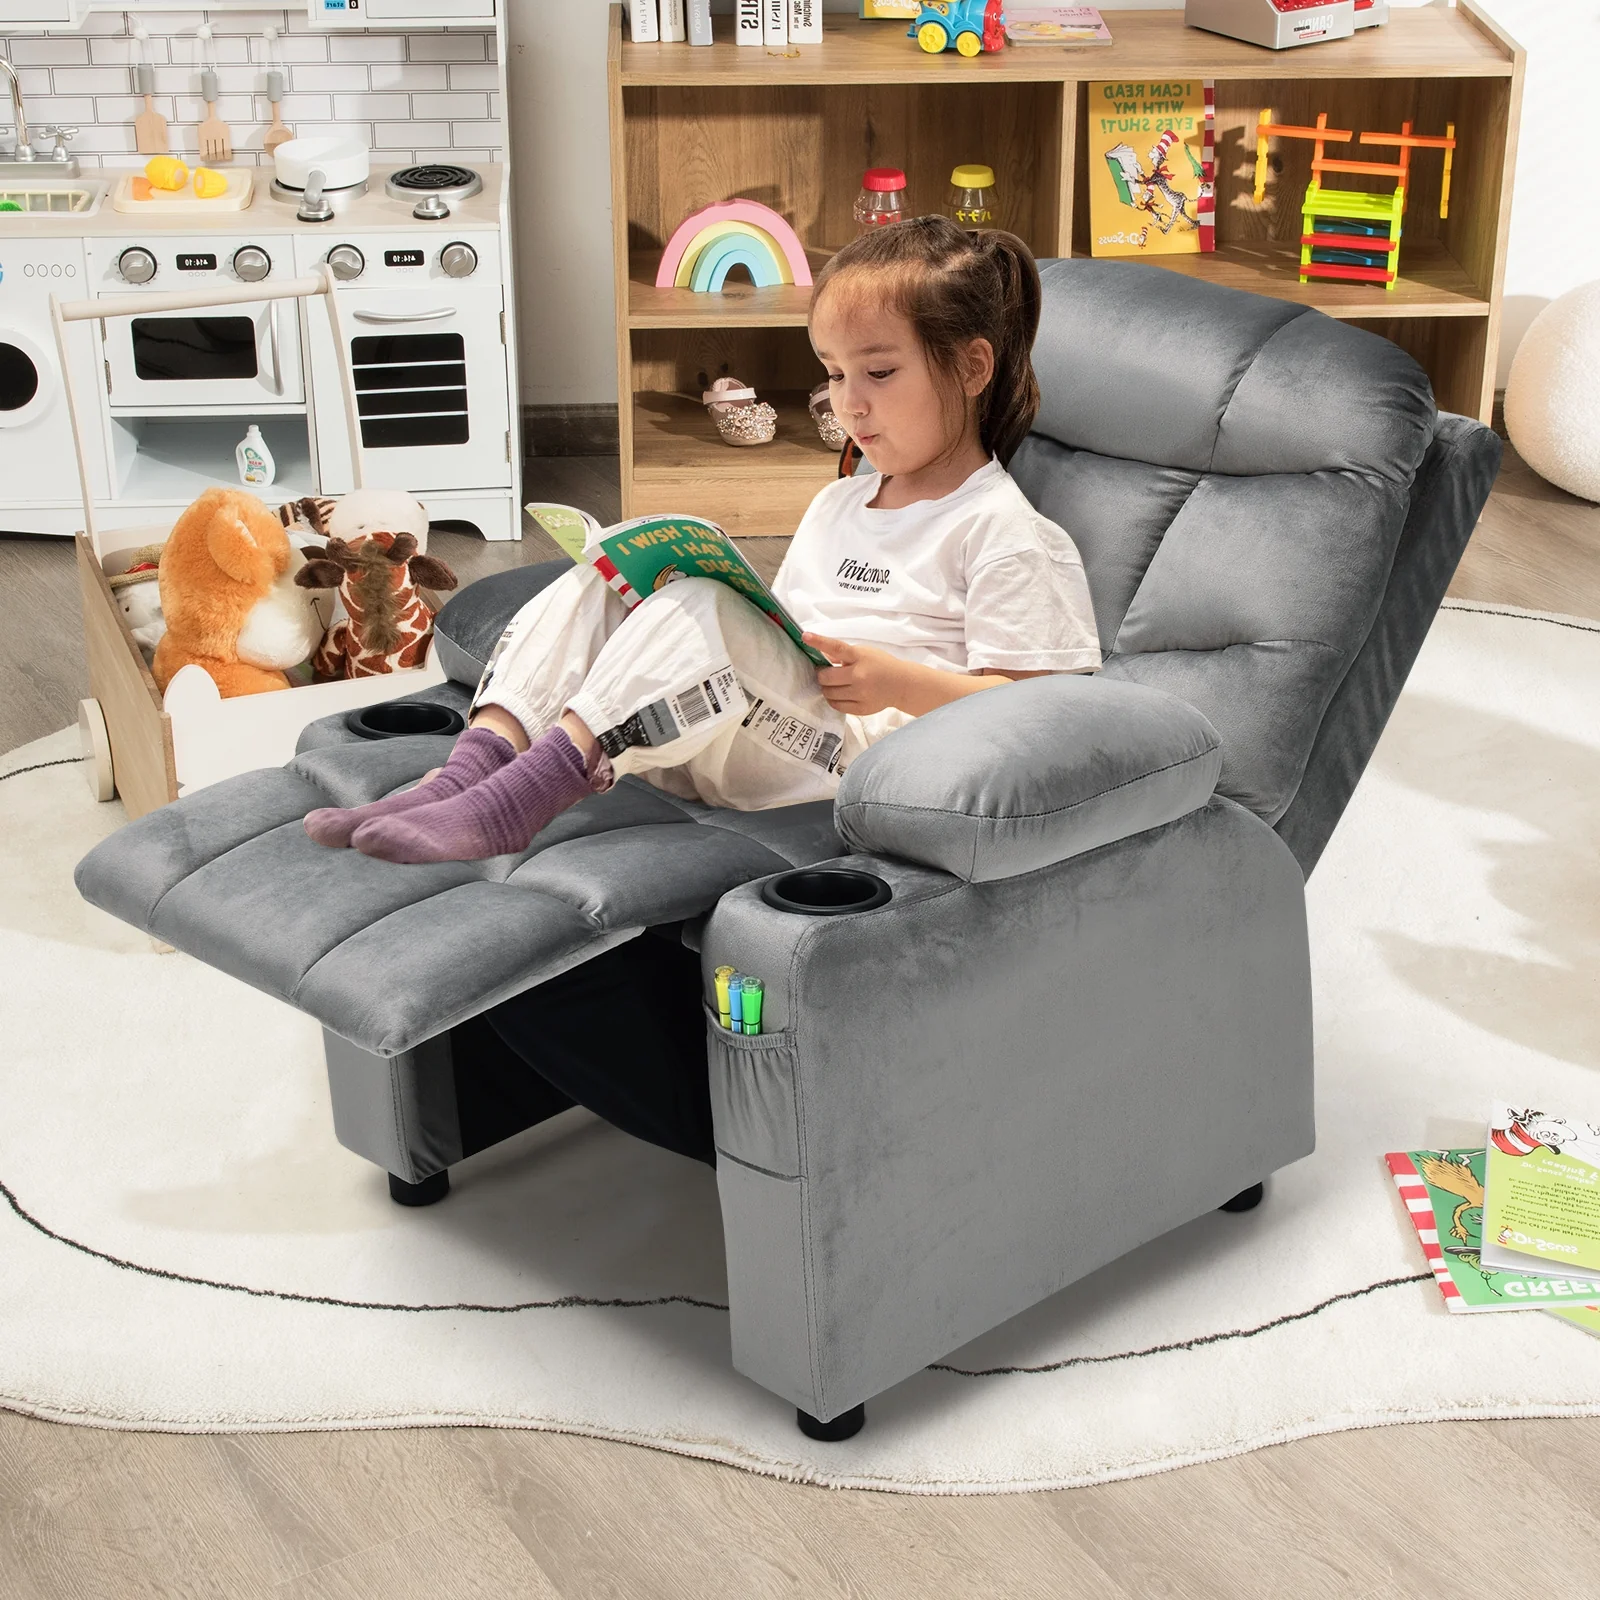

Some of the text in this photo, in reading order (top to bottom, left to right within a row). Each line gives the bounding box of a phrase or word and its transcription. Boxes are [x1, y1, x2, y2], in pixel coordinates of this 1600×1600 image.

[616, 542, 631, 556] I
[628, 525, 682, 549] WISH
[671, 542, 724, 558] I HAD
[782, 720, 798, 742] JFK
[798, 728, 813, 750] GDY
